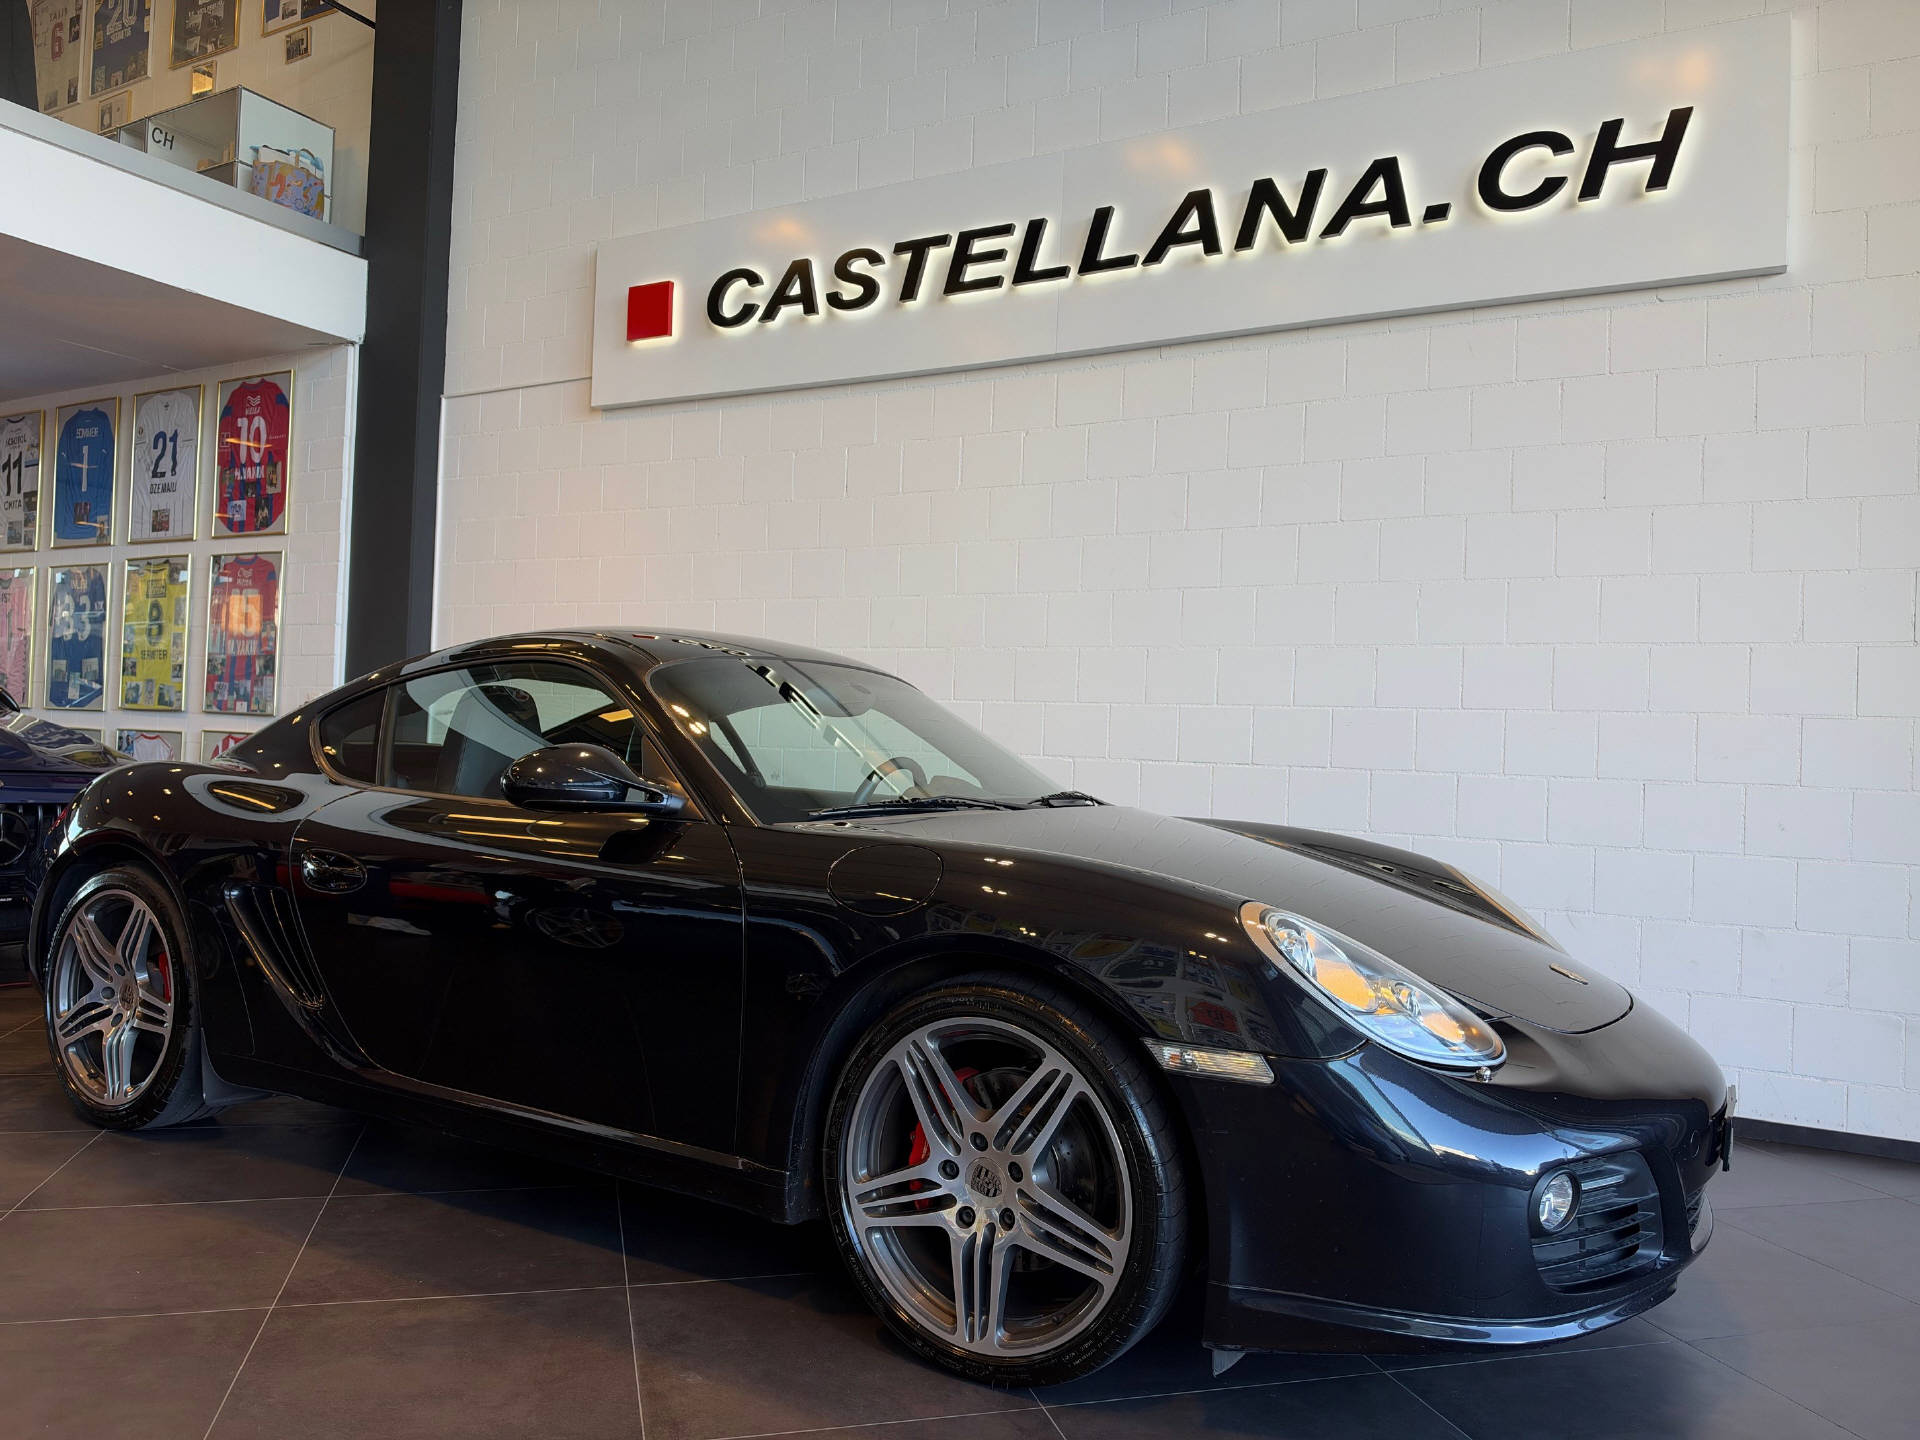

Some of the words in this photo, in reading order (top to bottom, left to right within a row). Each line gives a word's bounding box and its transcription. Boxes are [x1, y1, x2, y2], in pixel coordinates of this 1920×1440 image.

[152, 127, 174, 150] CH
[706, 106, 1694, 329] CASTELLANA.CH
[151, 428, 178, 478] 21
[237, 416, 267, 464] 10
[2, 451, 22, 496] 11
[81, 445, 89, 492] 1
[146, 600, 163, 646] 8
